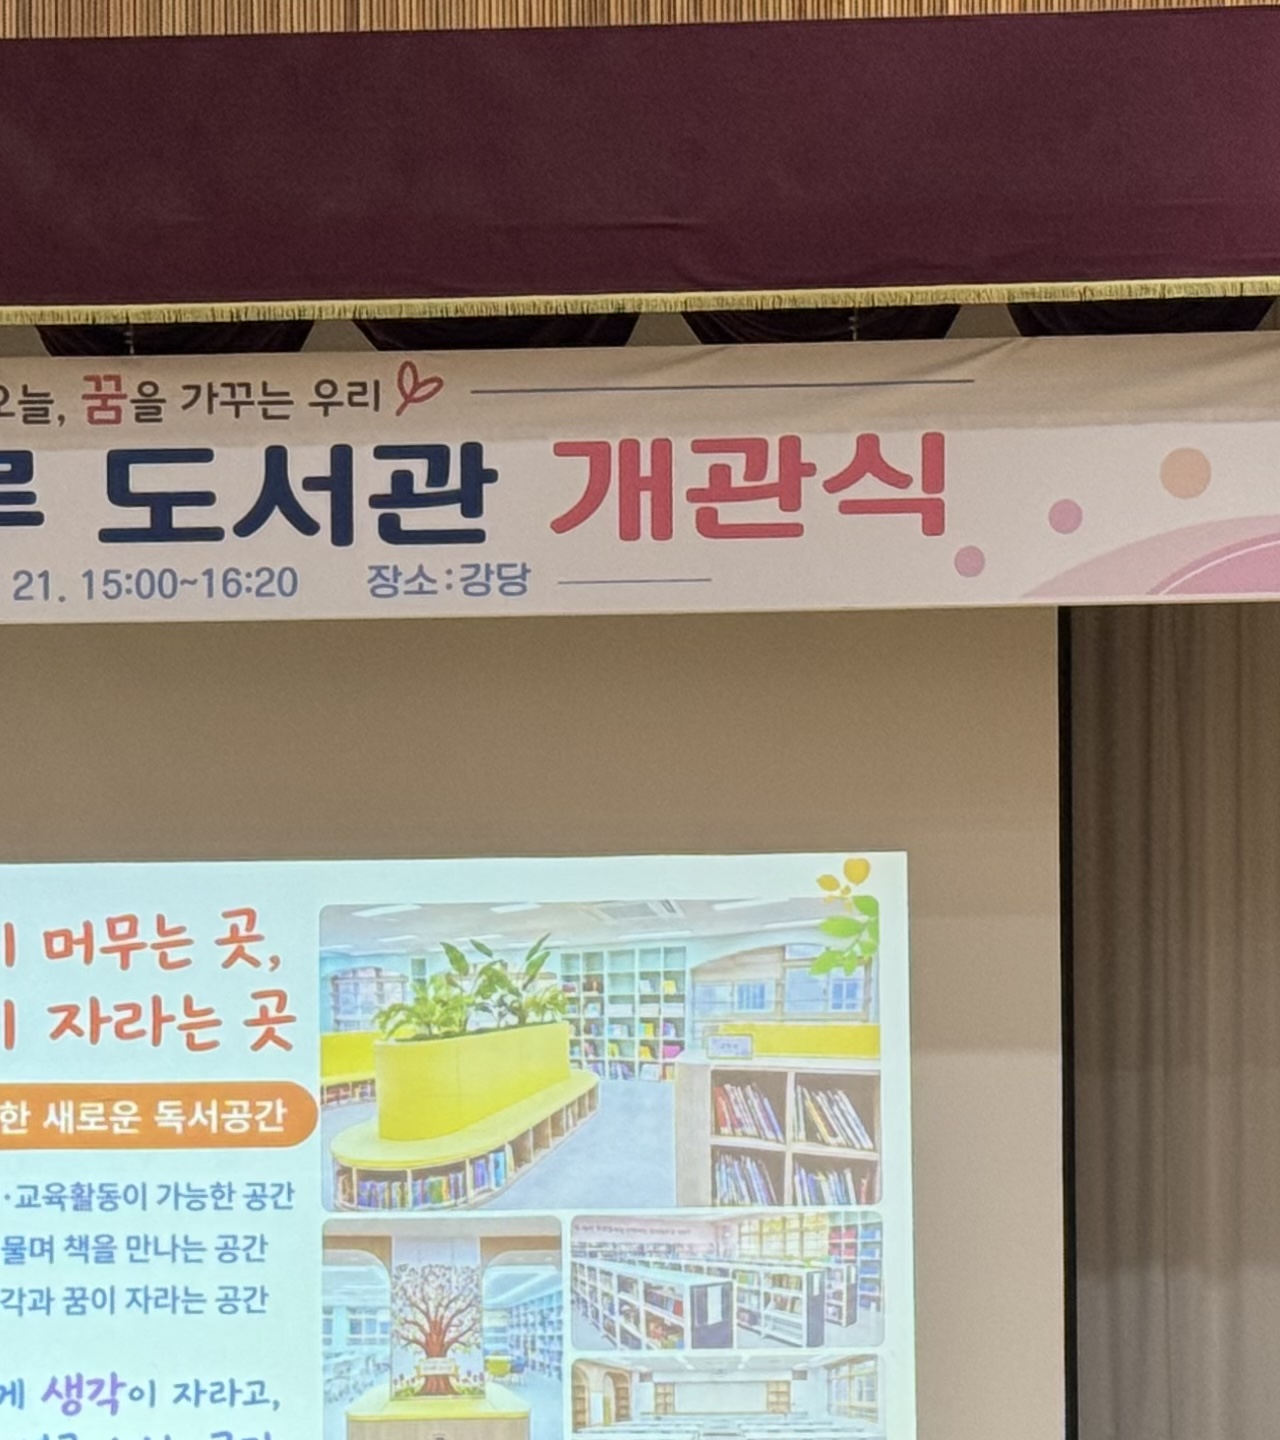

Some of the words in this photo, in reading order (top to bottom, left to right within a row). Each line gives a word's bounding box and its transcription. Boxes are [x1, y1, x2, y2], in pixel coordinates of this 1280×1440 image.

[82, 375, 166, 424] 꿈을
[182, 381, 294, 420] 가꾸는
[309, 379, 379, 417] 우리
[98, 442, 498, 547] 도서관
[550, 432, 945, 541] 개관식
[13, 570, 65, 602] 21.
[43, 914, 193, 970] 머무는
[215, 908, 280, 971] 곳,
[48, 995, 222, 1051] 자라는
[244, 990, 296, 1051] 곳
[43, 1100, 141, 1134] 새로운
[154, 1098, 287, 1134] 독서공간
[157, 1182, 236, 1211] 가능한
[243, 1182, 295, 1211] 공간
[64, 1234, 117, 1264] 책을
[126, 1234, 207, 1263] 만나는
[215, 1234, 268, 1263] 공간
[63, 1285, 115, 1315] 꿈이
[126, 1285, 207, 1314] 자라는
[215, 1286, 269, 1315] 공간
[41, 1372, 155, 1416] 생각이
[173, 1378, 279, 1411] 자라고,
